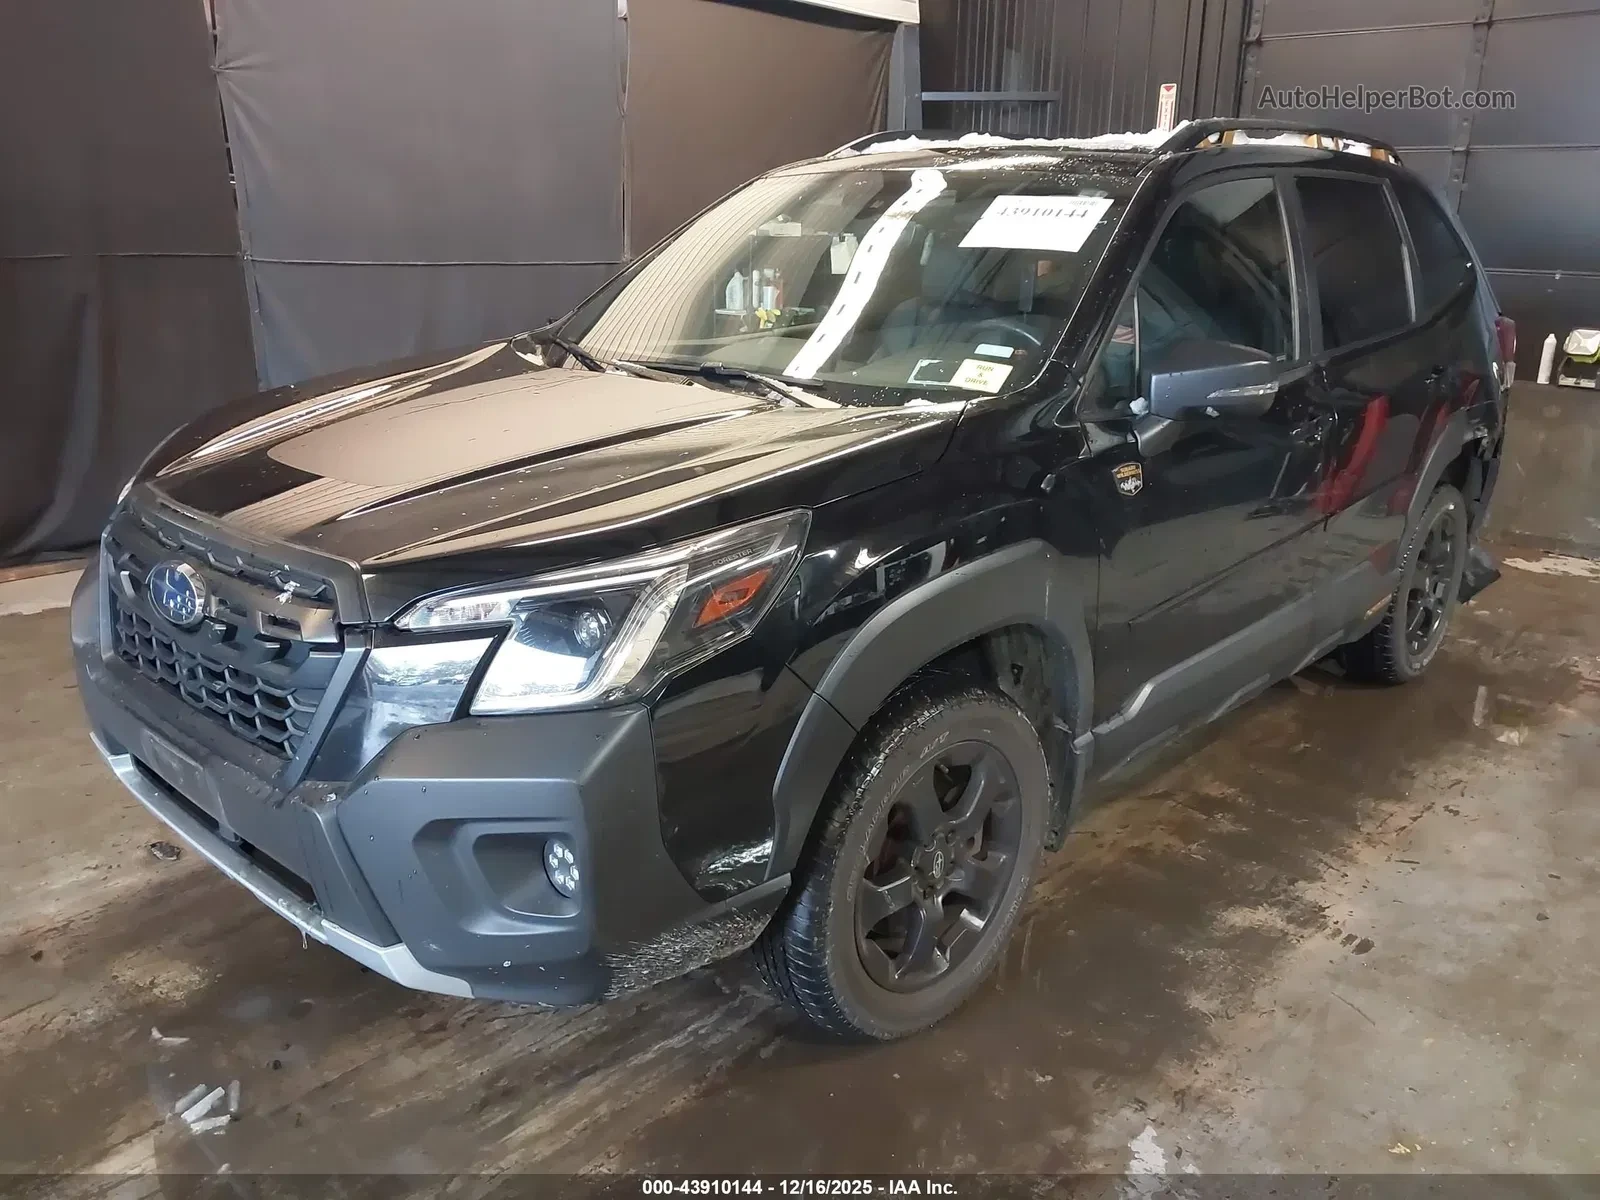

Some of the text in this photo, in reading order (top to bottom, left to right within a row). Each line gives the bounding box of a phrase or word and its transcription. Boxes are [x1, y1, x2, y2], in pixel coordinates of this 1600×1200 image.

[976, 364, 995, 372] RUN
[965, 377, 988, 386] DRIVE
[712, 548, 753, 567] FORESTER
